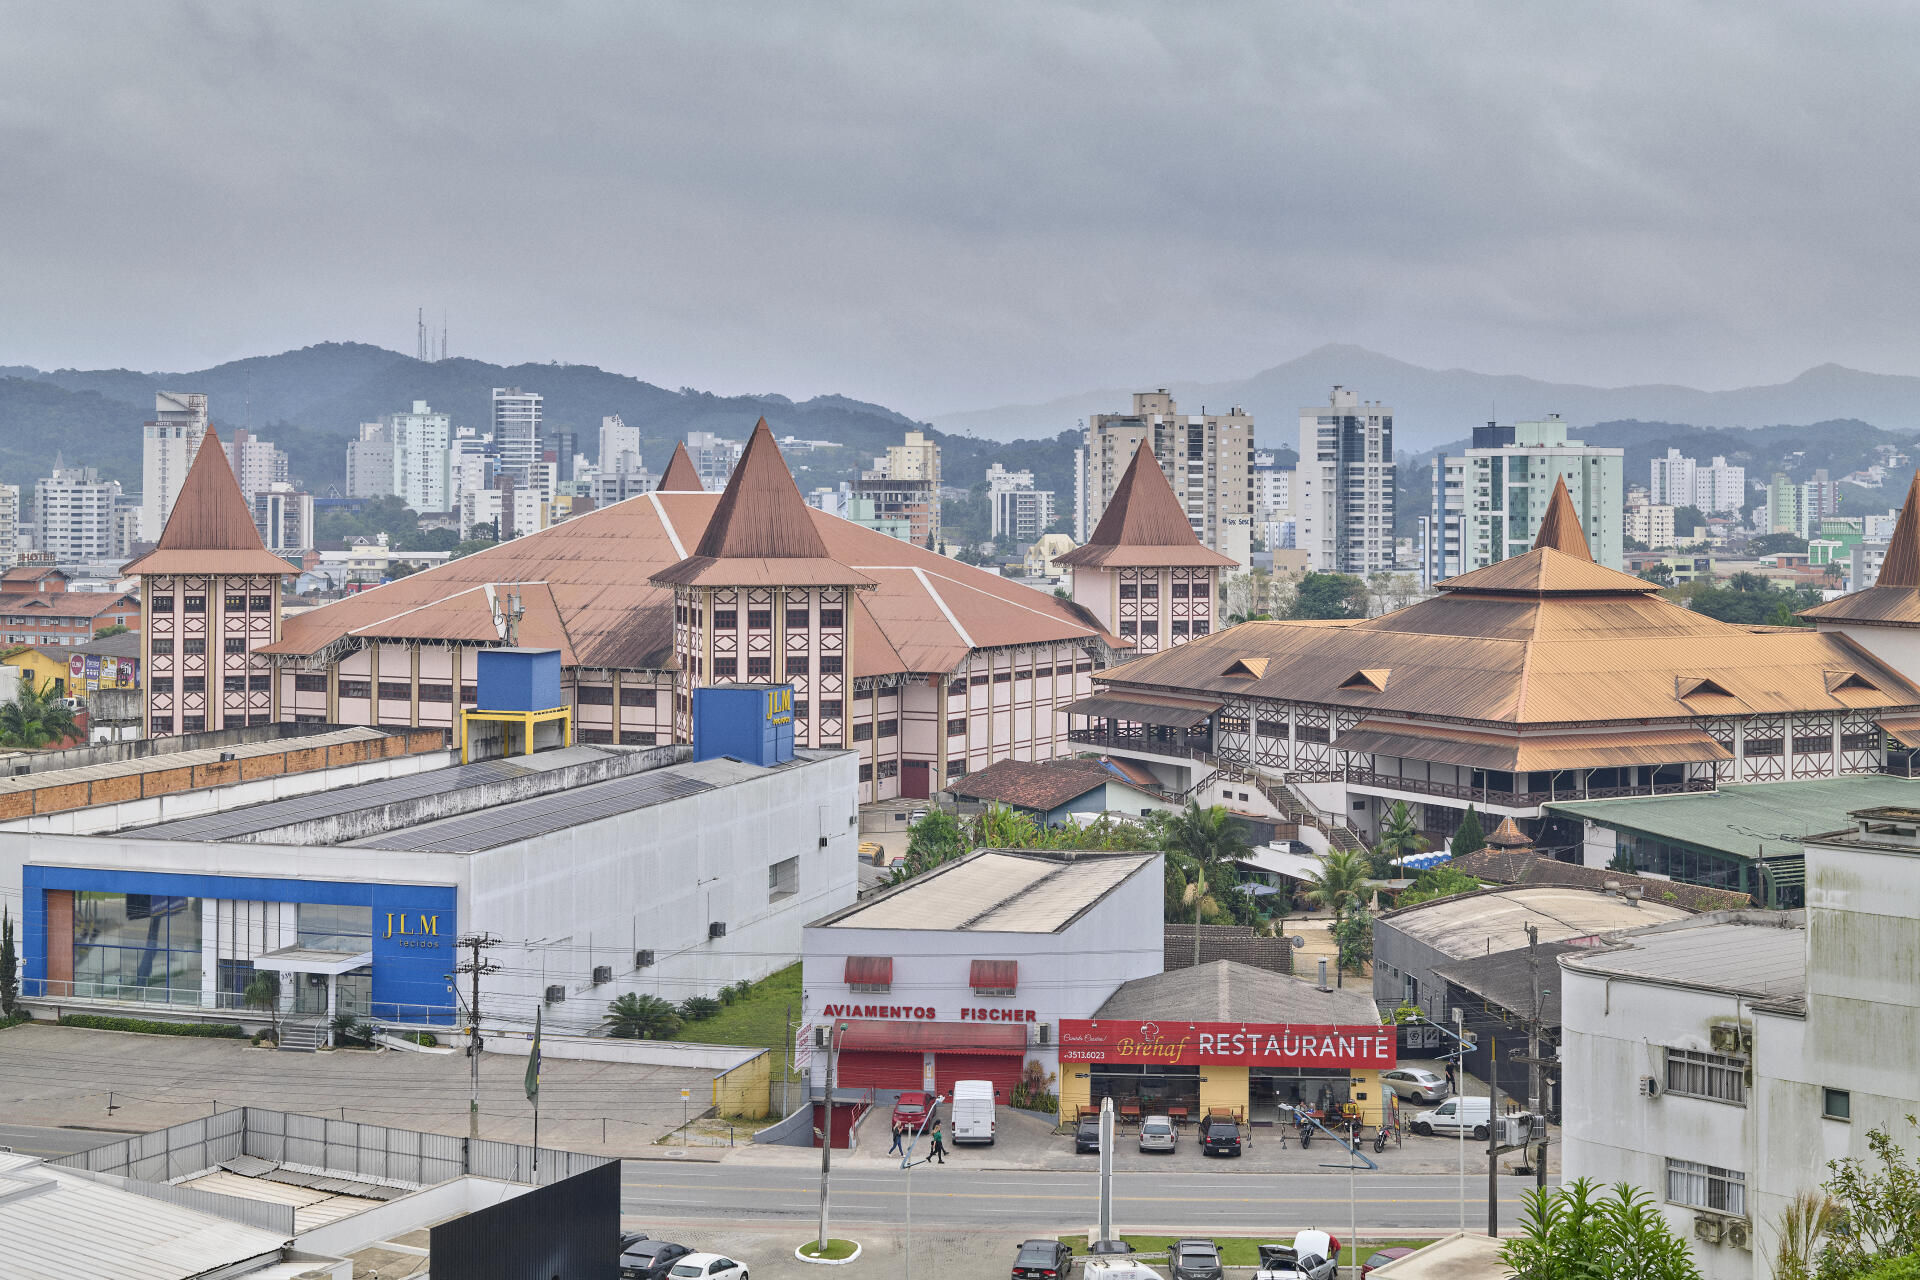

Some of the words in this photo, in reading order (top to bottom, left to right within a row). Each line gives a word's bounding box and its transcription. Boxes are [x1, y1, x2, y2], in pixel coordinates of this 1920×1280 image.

[20, 552, 56, 561] HOTEL
[766, 689, 791, 720] JLM
[382, 912, 440, 939] JLM
[399, 938, 439, 948] tecidos
[823, 1004, 936, 1019] AVIAMENTOS
[960, 1007, 1037, 1022] FISCHER
[1117, 1035, 1191, 1063] Brehaf
[1199, 1033, 1389, 1059] RESTAURANTE
